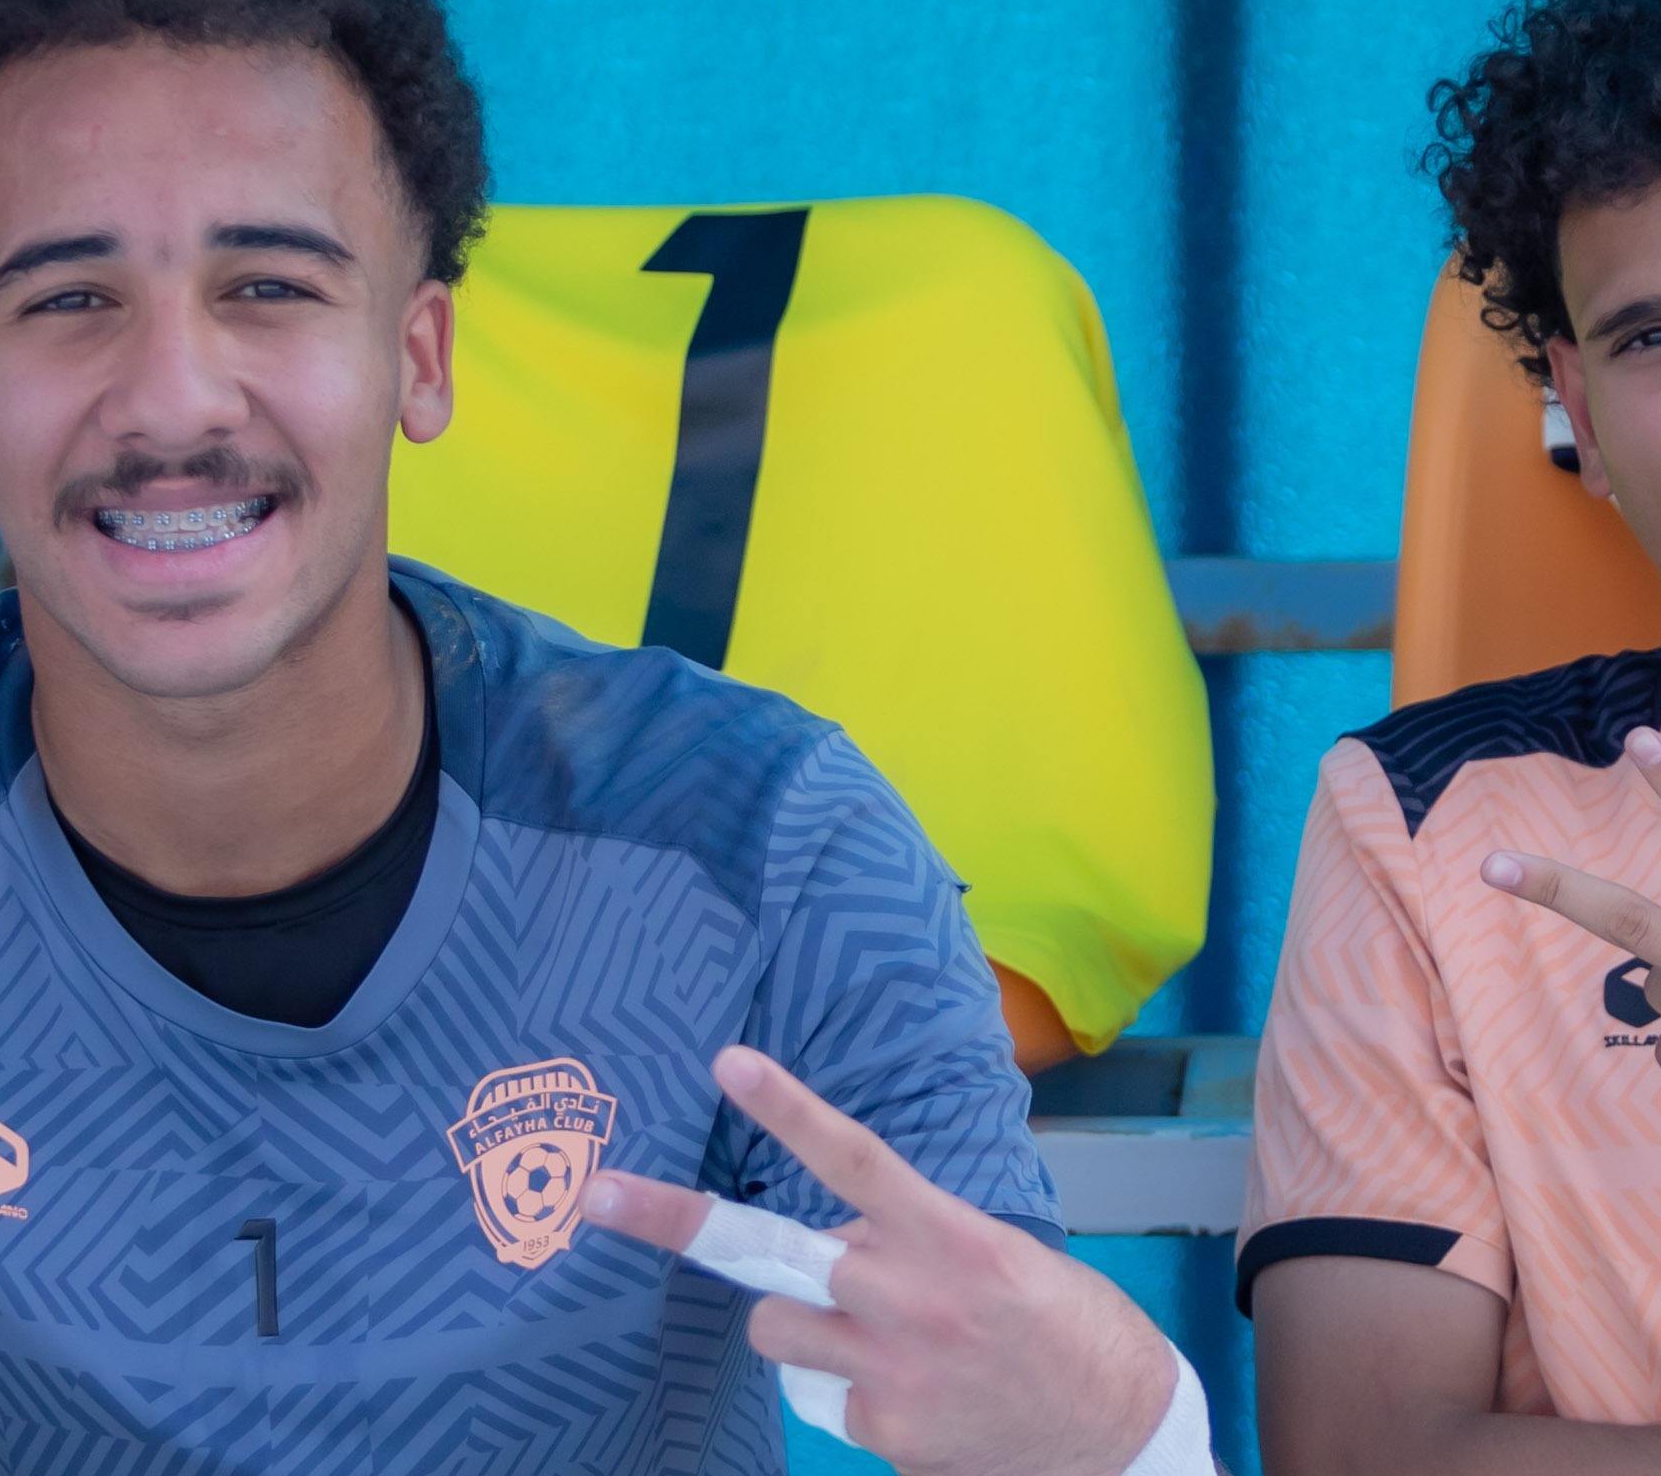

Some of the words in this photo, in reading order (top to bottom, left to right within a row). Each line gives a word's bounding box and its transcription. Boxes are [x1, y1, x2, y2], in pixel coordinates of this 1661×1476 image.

[640, 206, 811, 671] 1
[475, 1117, 548, 1155] ALFAYHA
[553, 1115, 595, 1133] CLUB
[236, 1217, 279, 1338] 1
[523, 1235, 550, 1252] 1953
